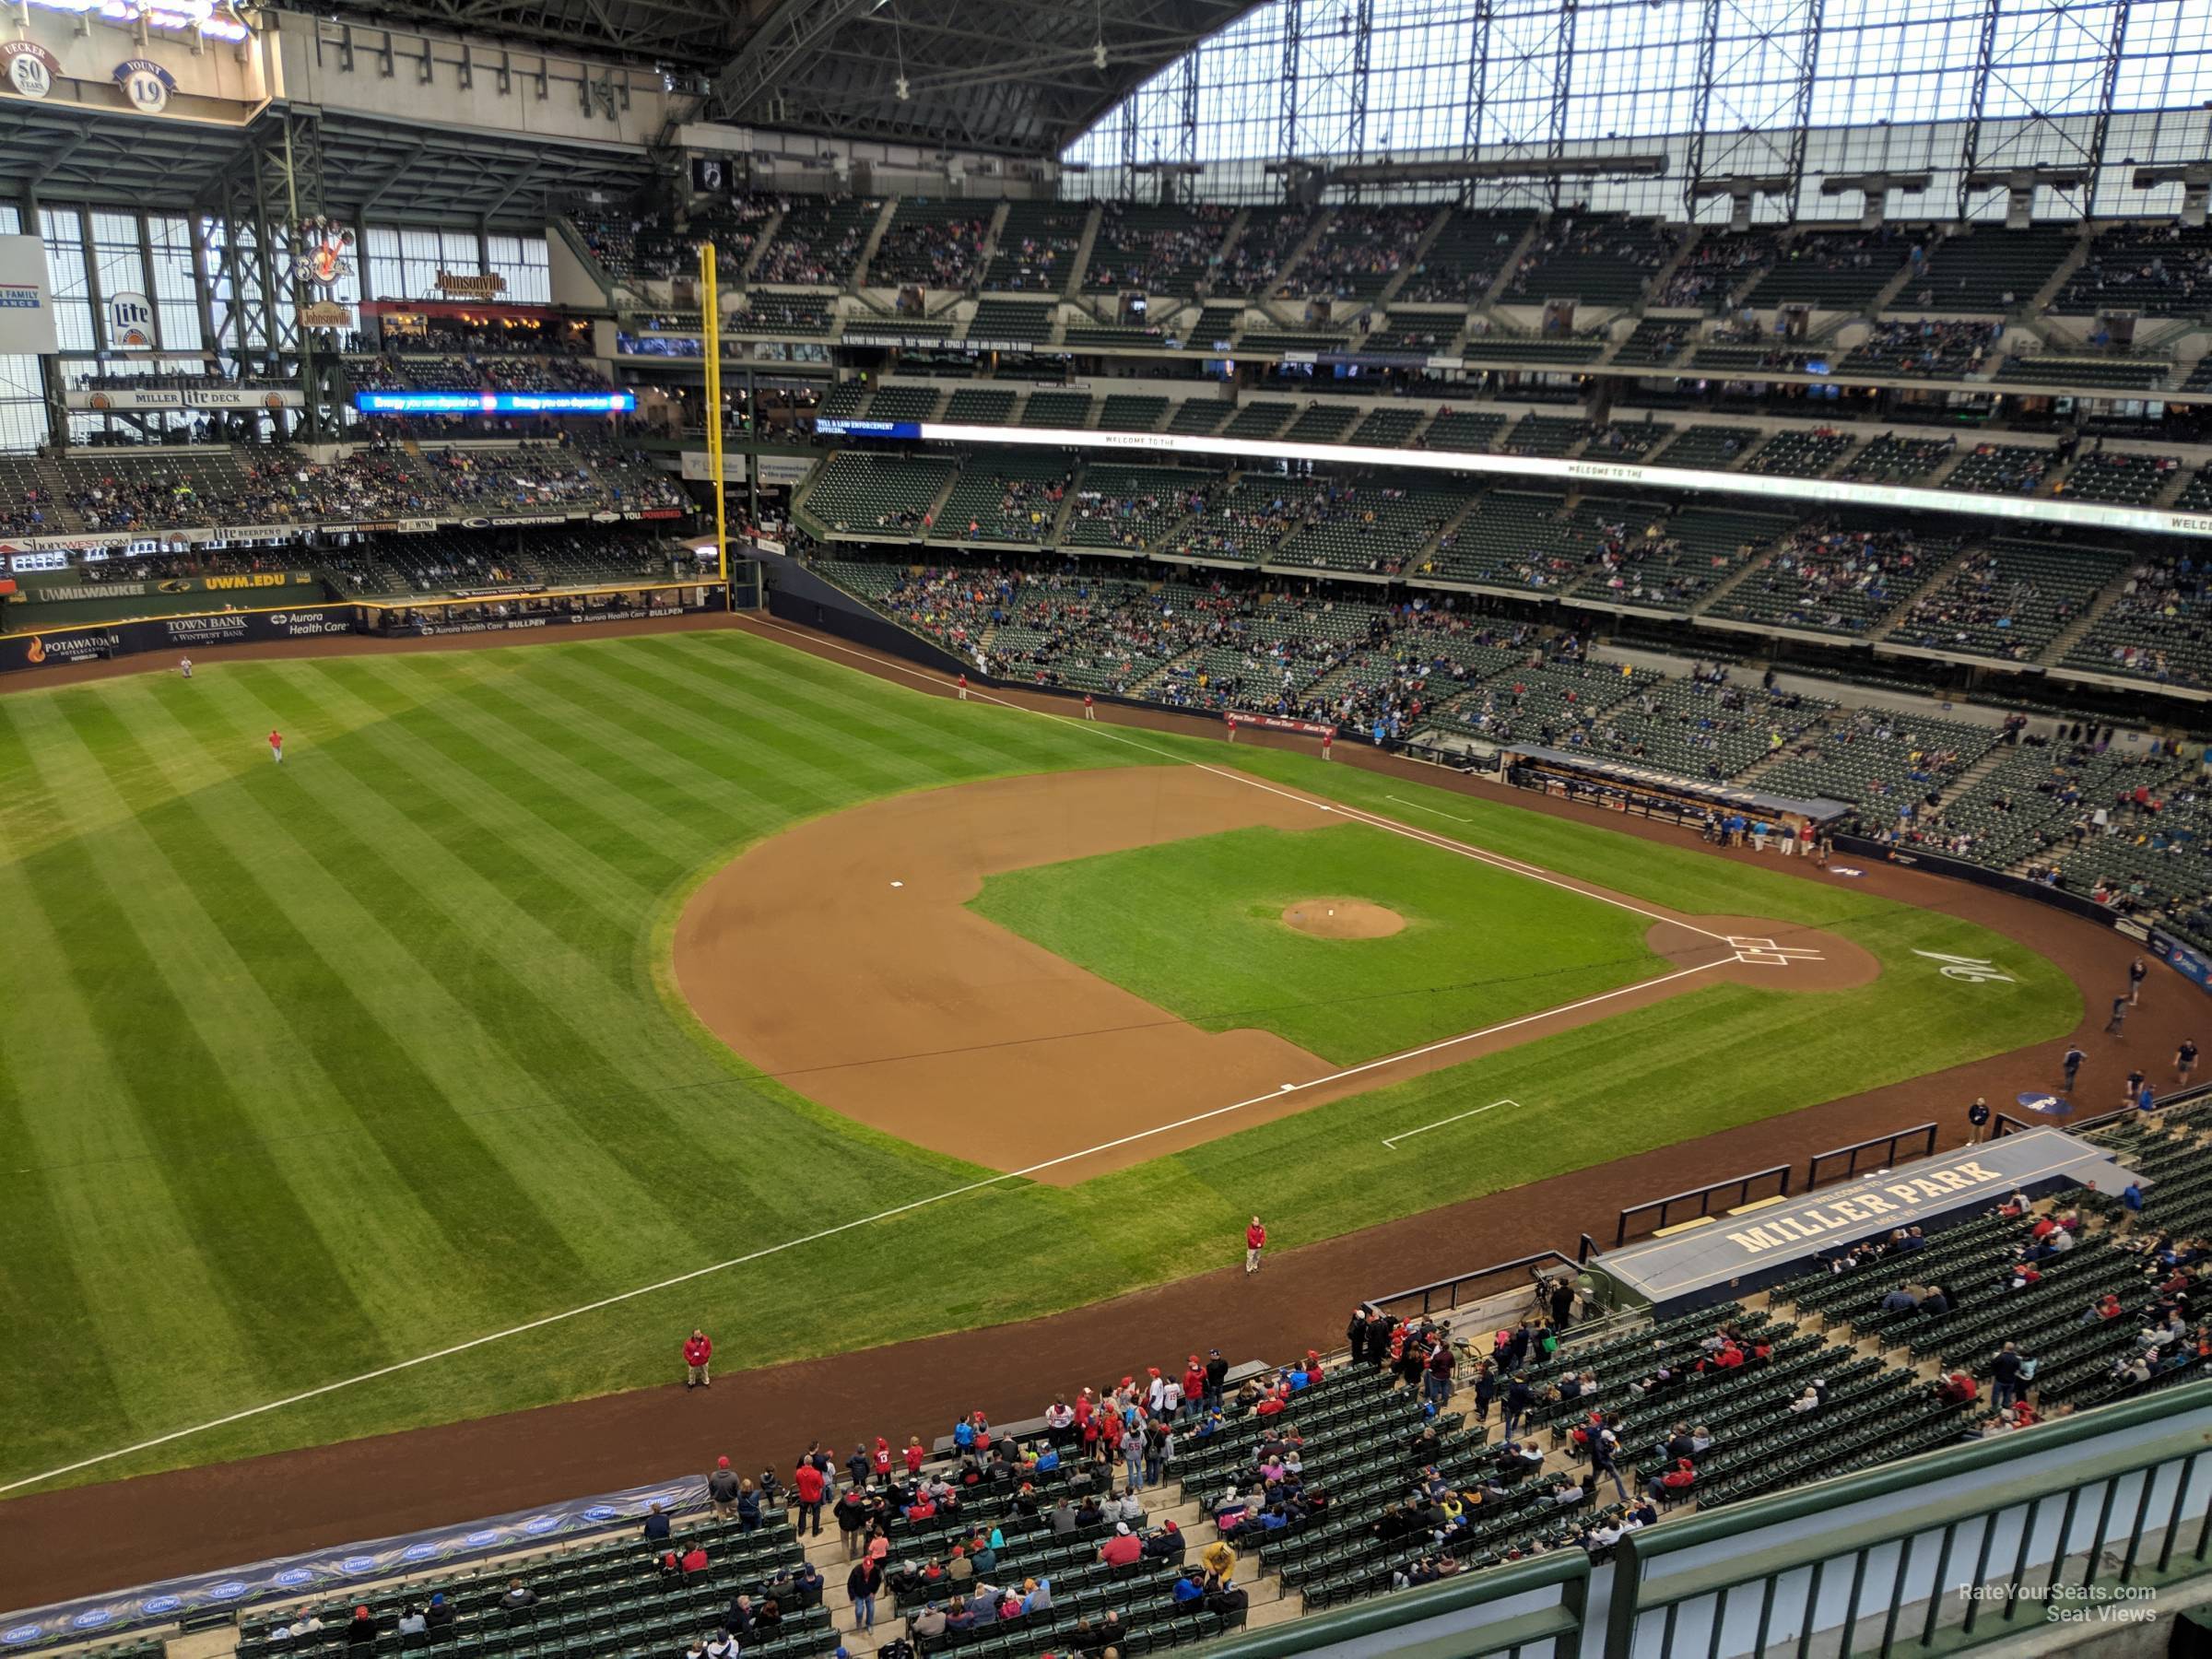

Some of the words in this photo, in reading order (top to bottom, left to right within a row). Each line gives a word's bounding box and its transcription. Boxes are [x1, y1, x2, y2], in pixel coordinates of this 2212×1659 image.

[5, 42, 45, 59] UECKER
[17, 58, 41, 81] 50
[127, 60, 162, 76] YOUNT
[20, 80, 43, 89] YEARS
[135, 78, 161, 104] 19
[434, 270, 507, 291] Johnsonville
[6, 289, 39, 300] FAMILY
[114, 302, 148, 328] Lite
[305, 312, 350, 325] Johnsonville
[135, 394, 178, 404] MILLER
[182, 390, 207, 406] Lite
[211, 394, 241, 404] DECK
[817, 419, 830, 428] TELL
[837, 420, 850, 429] LAW
[852, 421, 893, 430] ENFORCEMENT
[1106, 436, 1145, 444] WELCOME
[1149, 438, 1158, 446] TO
[1569, 465, 1608, 477] WELCOME
[1613, 468, 1624, 477] TO
[1628, 470, 1642, 478] THE
[322, 524, 358, 534] WISCONSIN'S
[358, 524, 375, 532] RADIO
[375, 523, 398, 532] STATION
[415, 520, 433, 530] WTMJ
[239, 528, 275, 537] BEERPEN
[206, 574, 286, 590] UWM.EDU
[289, 613, 323, 624] Aurora
[583, 614, 607, 622] Aurora
[608, 612, 629, 620] Health
[649, 608, 684, 618] BULLPEN
[167, 618, 207, 631] TOWN
[210, 616, 248, 629] BANK
[289, 623, 323, 635] Health
[324, 622, 348, 631] Care
[435, 626, 461, 634] Aurora
[462, 623, 487, 632] Health
[509, 619, 546, 629] BULLPEN
[179, 631, 220, 641] WINTRUST
[223, 629, 244, 638] BANK
[1811, 1184, 1866, 1204] WELCOME
[1865, 1180, 1883, 1188] TO
[1725, 1193, 1900, 1253] MILLER
[1884, 1161, 2003, 1204] PARK
[1900, 1208, 1919, 1217] WI
[1128, 1441, 1140, 1452] 55
[646, 1496, 669, 1506] Carrier
[588, 1508, 612, 1516] Carrier
[467, 1532, 494, 1543] Carrier
[407, 1545, 433, 1555] Carrier
[345, 1559, 370, 1568] Carrier
[280, 1571, 307, 1583] Carrier
[215, 1584, 242, 1595] Carrier
[147, 1599, 175, 1609] Carrier
[78, 1612, 108, 1624] Carrier
[6, 1628, 36, 1641] Carrier
